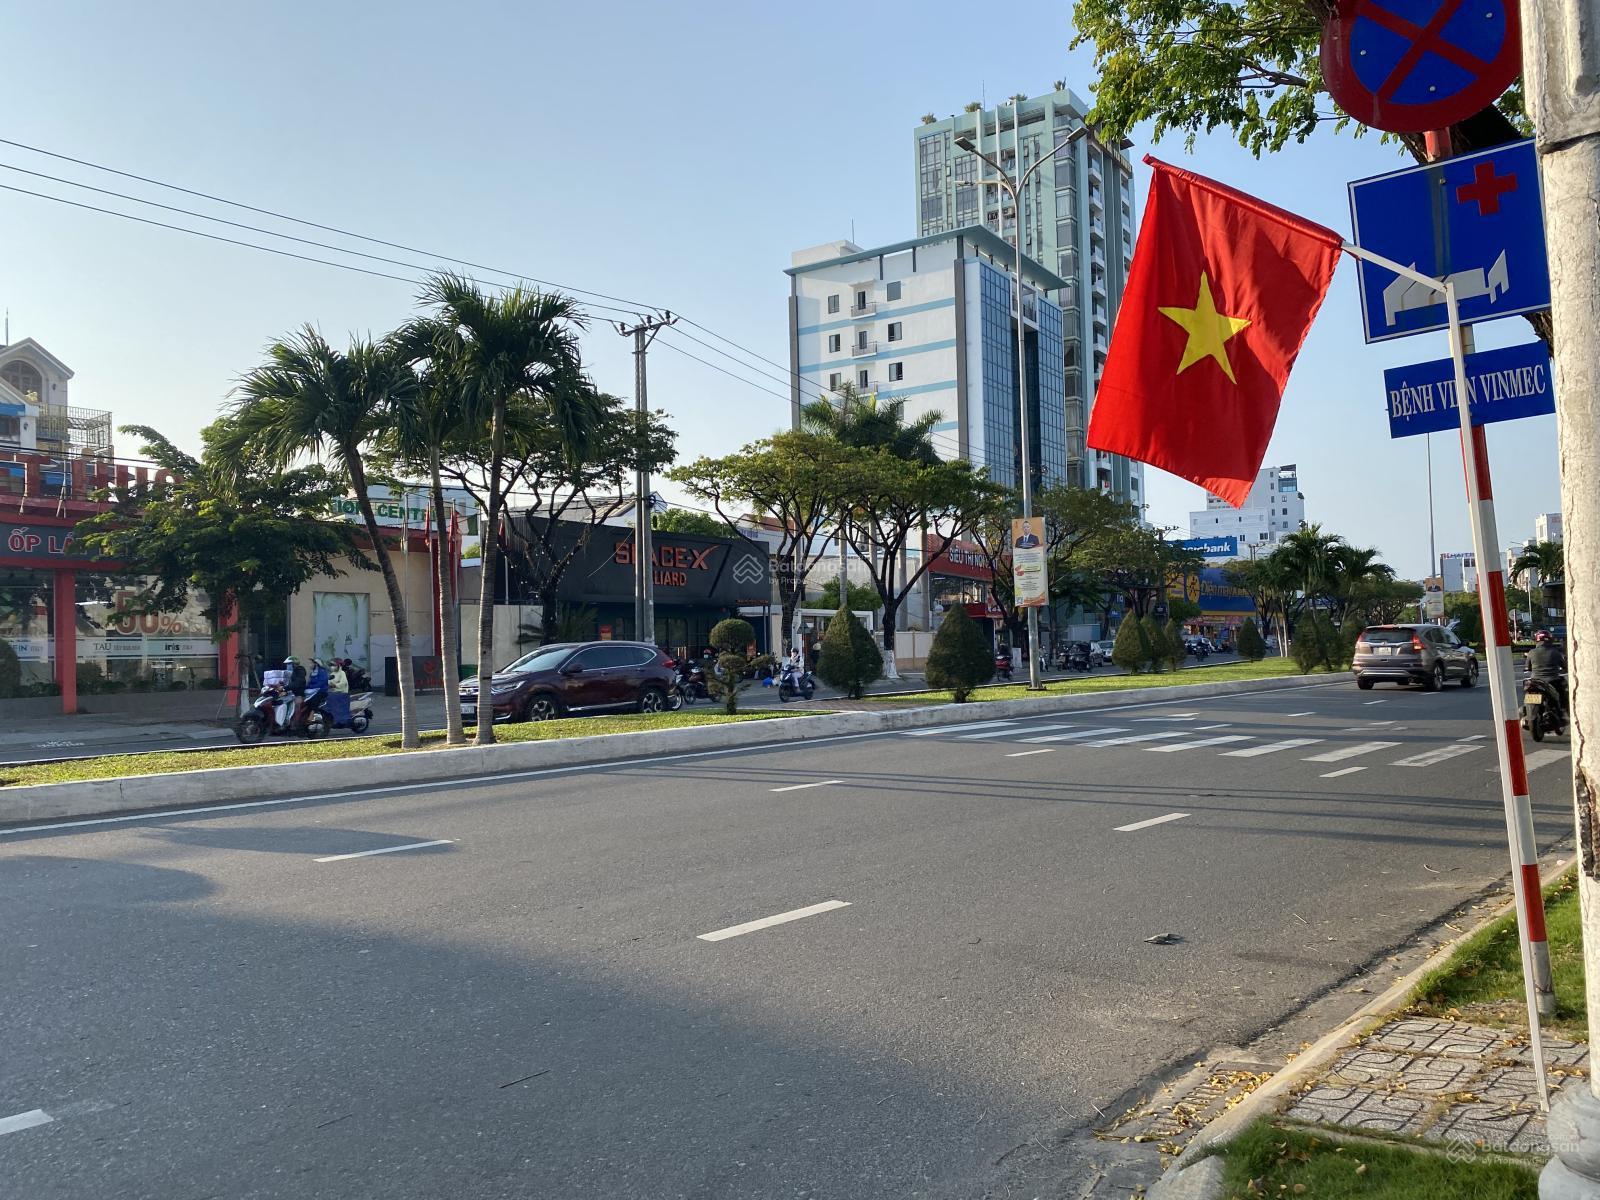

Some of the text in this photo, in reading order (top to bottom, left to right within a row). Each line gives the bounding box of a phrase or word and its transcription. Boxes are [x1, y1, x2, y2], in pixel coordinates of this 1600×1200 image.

[1390, 364, 1546, 422] BỆNH VIN VINMEC
[8, 527, 41, 552] ỐP
[615, 542, 720, 570] SACE-X
